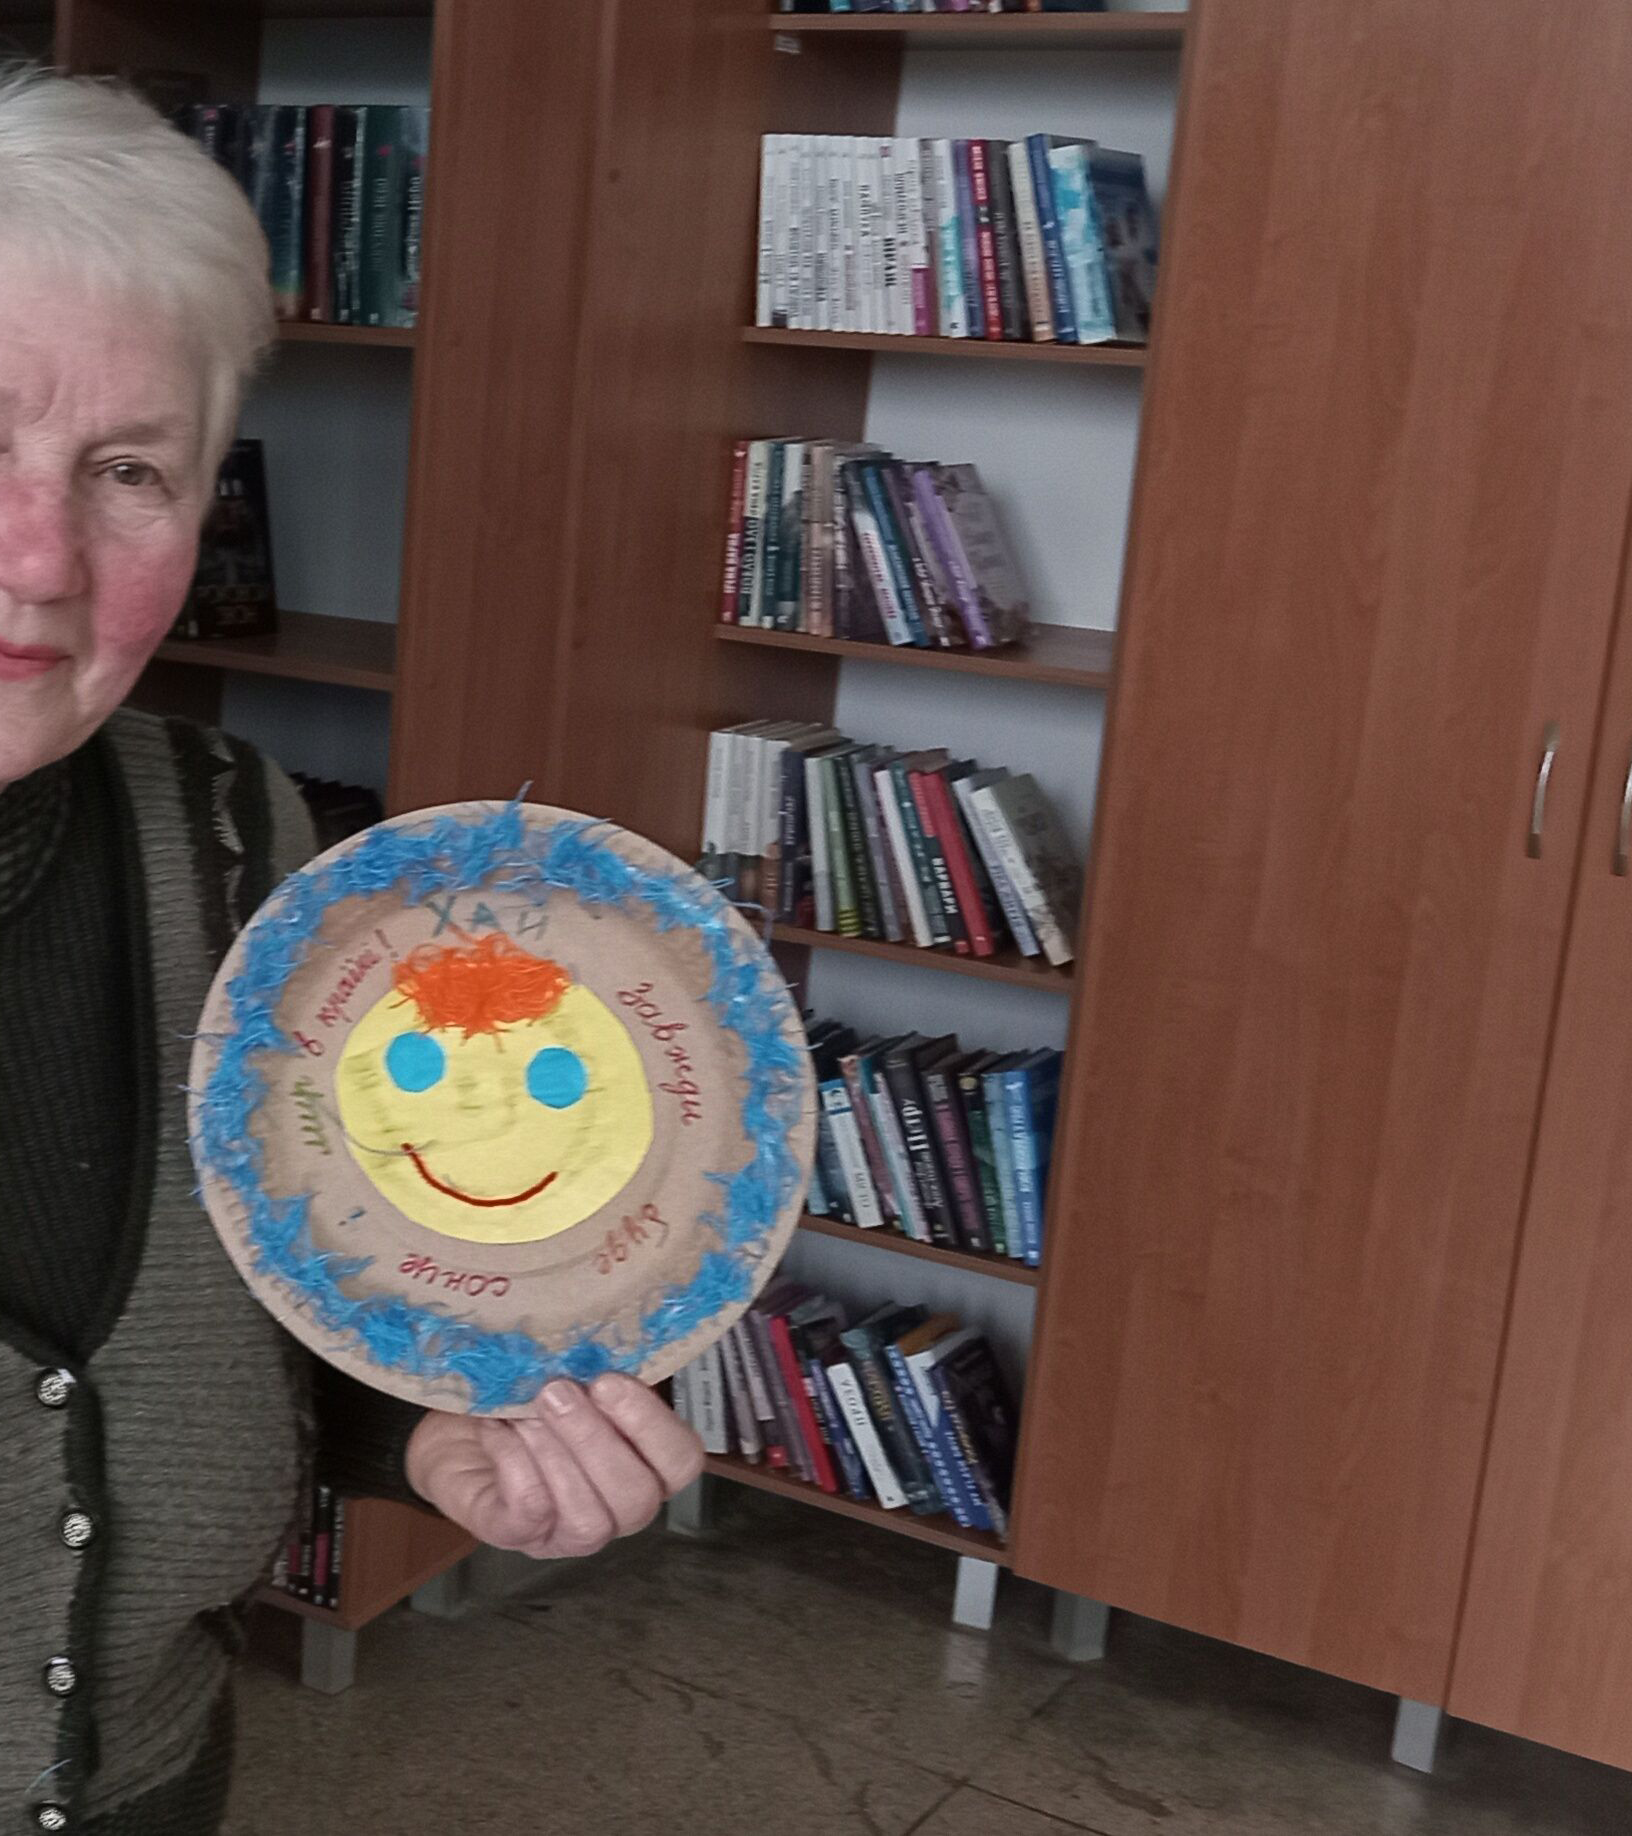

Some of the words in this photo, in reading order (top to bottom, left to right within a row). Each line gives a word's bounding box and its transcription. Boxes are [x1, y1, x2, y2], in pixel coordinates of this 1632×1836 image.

[423, 895, 550, 940] ХАЙ
[617, 982, 703, 1127] завжди
[593, 1203, 668, 1275] буде
